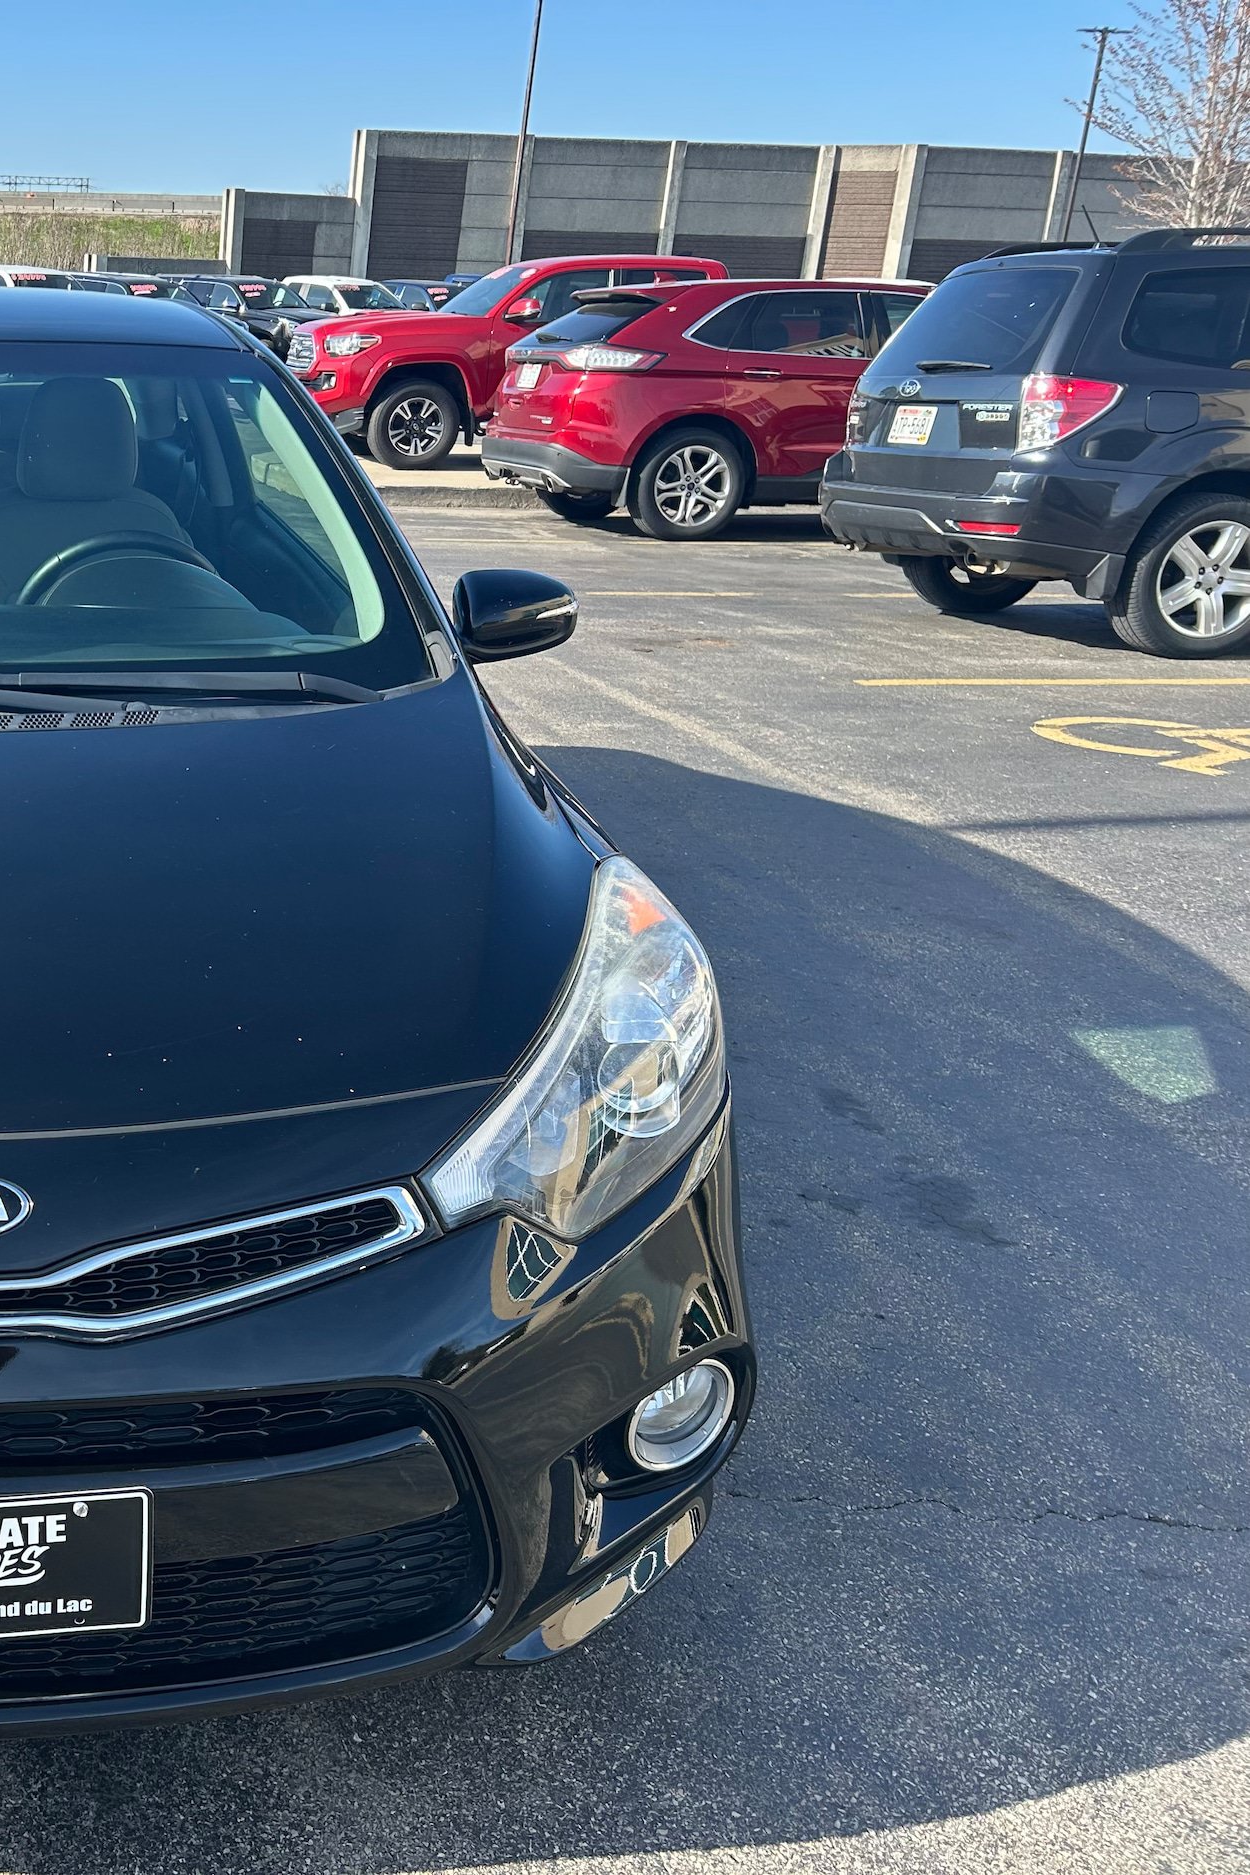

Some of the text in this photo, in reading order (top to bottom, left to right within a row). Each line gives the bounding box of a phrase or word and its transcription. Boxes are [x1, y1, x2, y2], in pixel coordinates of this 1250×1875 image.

[962, 403, 1014, 411] FORESTER
[24, 1599, 53, 1616] du
[56, 1597, 93, 1614] Lac
